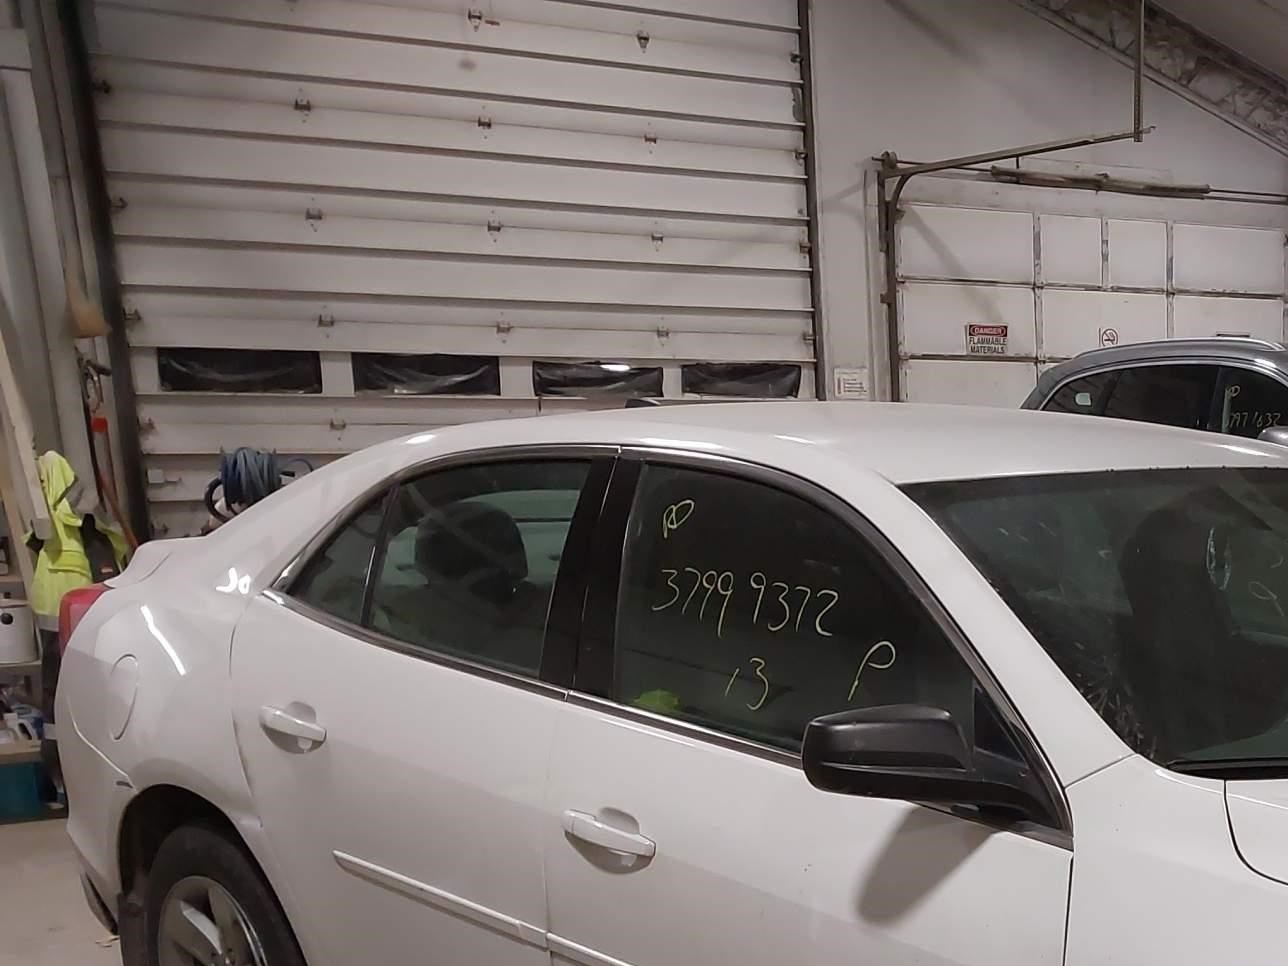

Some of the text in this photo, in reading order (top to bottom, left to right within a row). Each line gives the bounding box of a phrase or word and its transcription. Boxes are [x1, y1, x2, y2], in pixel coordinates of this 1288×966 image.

[968, 336, 1007, 346] FLAMMABLE
[970, 345, 1005, 354] MATERIALS
[651, 567, 840, 639] 3799 9372
[724, 657, 770, 711] 13
